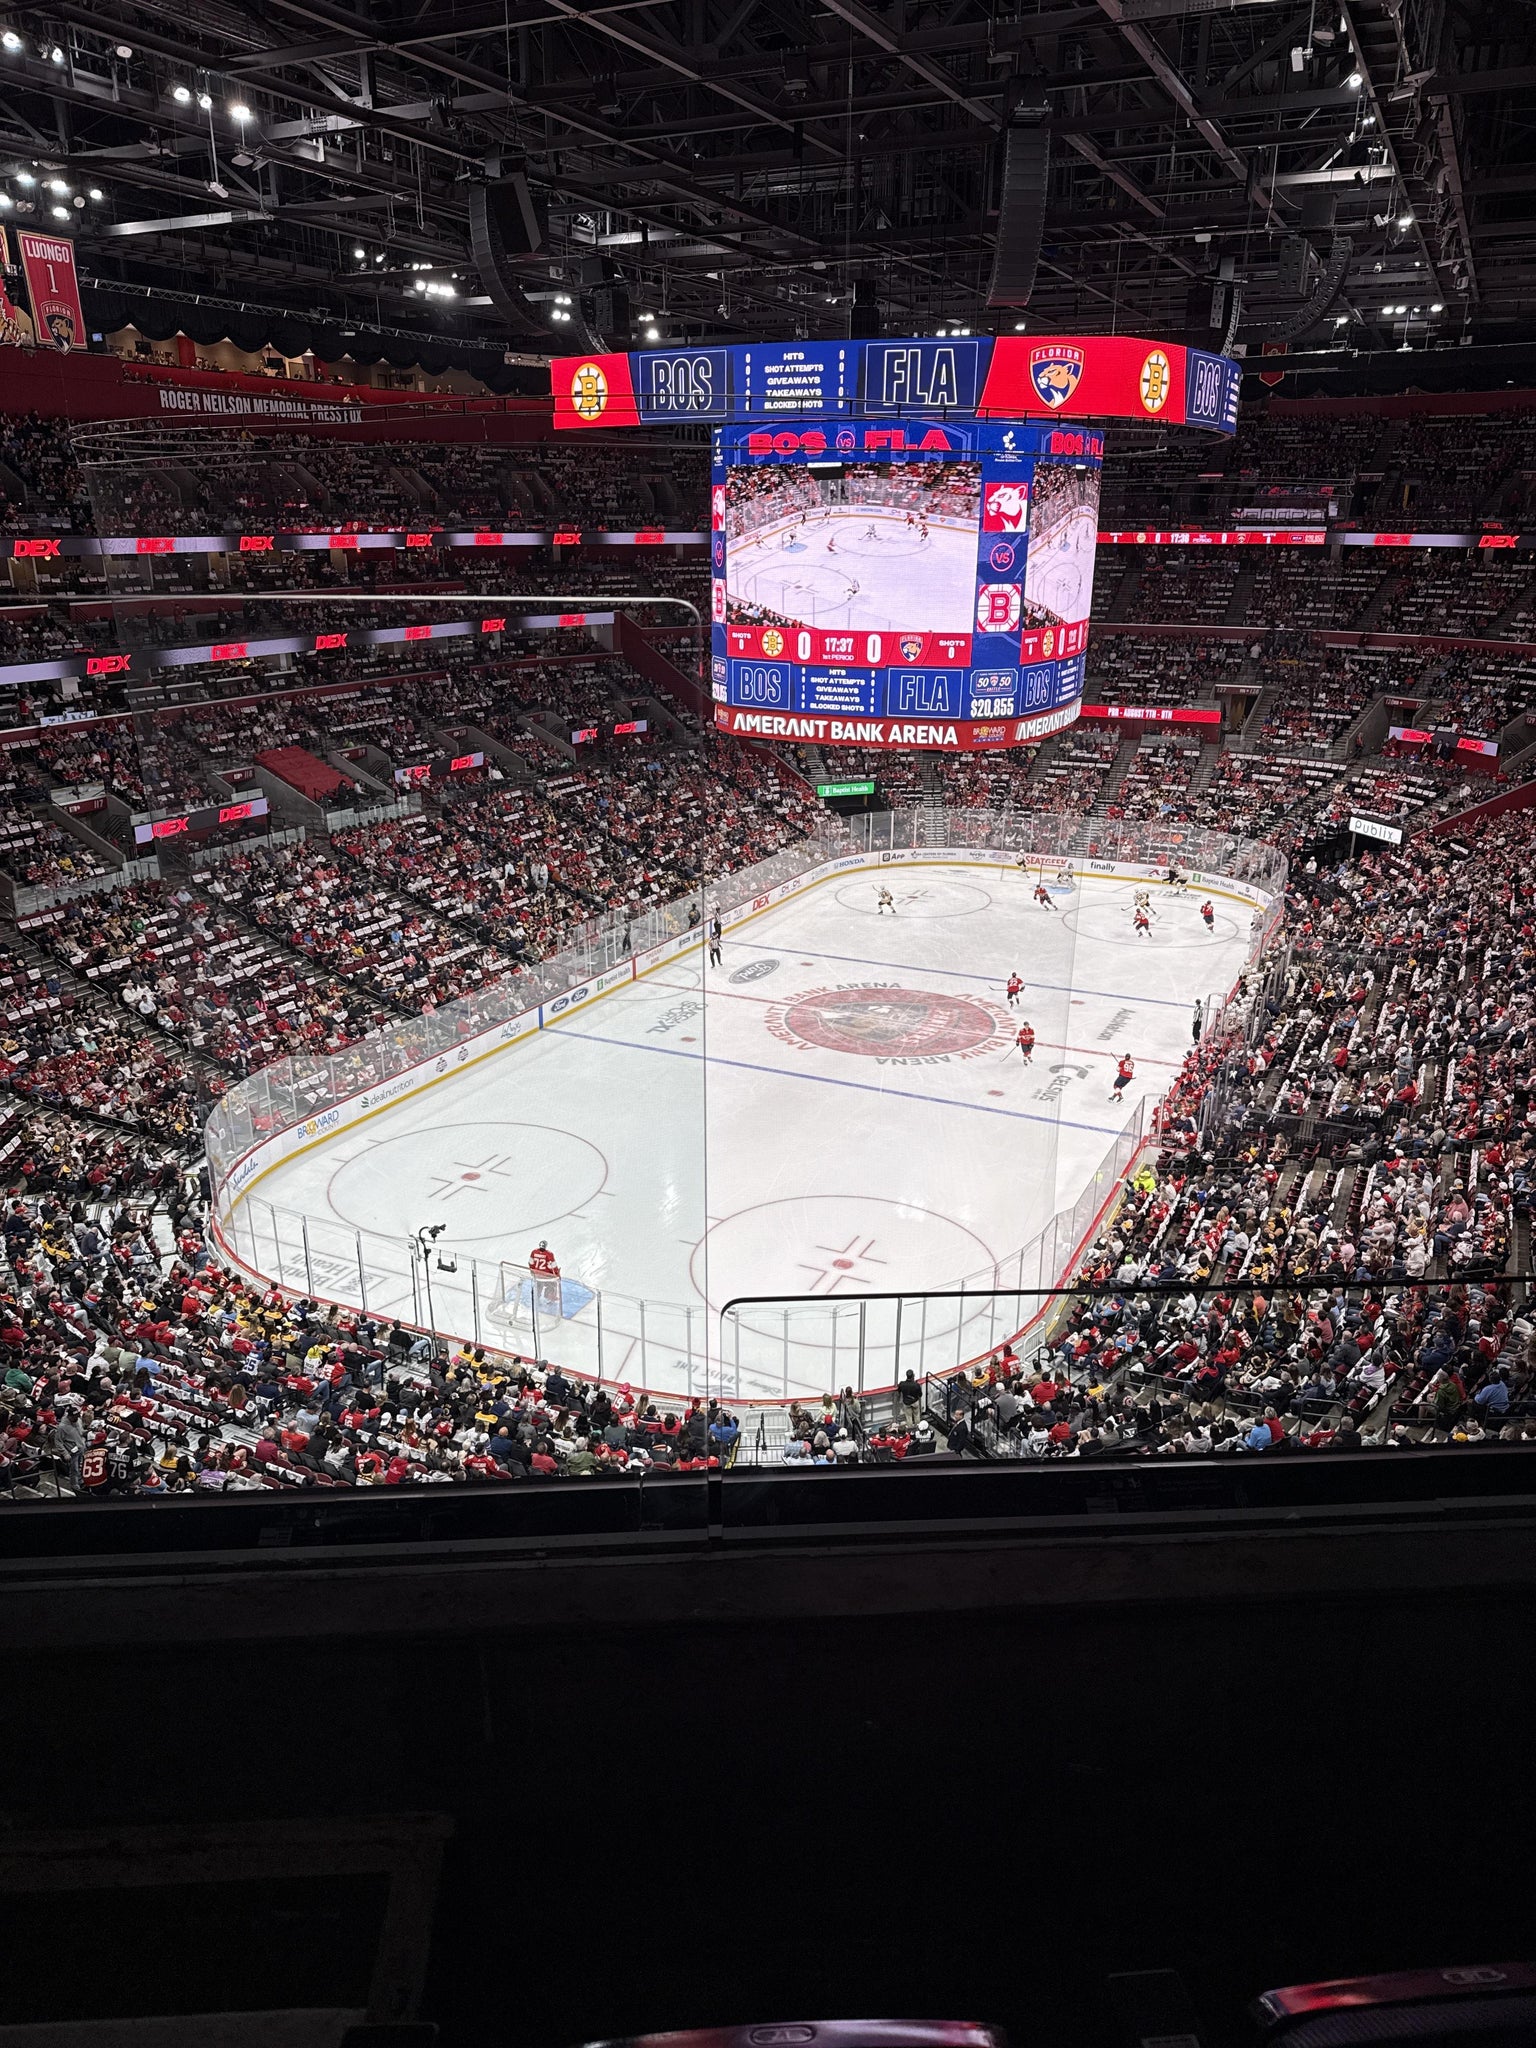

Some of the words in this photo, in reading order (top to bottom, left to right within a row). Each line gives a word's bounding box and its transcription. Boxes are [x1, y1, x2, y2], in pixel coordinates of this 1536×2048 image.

[25, 239, 70, 264] LUONGO
[46, 264, 59, 293] 1
[45, 305, 71, 317] FLORIDA
[745, 353, 750, 364] 0
[783, 352, 804, 361] HITS
[839, 350, 844, 360] 0
[1035, 347, 1079, 361] FLORIDA
[764, 365, 784, 374] SHOT
[785, 364, 824, 373] ATTEMPTS
[839, 362, 844, 373] 0
[652, 357, 712, 412] BOS
[746, 377, 750, 387] 1
[767, 376, 821, 386] GIVEAWAYS
[839, 374, 843, 385] 1
[883, 348, 957, 406] FLA
[1147, 363, 1164, 399] B
[580, 374, 598, 408] B
[765, 388, 822, 397] TAKEAWAYS
[838, 386, 844, 397] 0
[1193, 360, 1221, 417] BOS
[159, 390, 201, 411] ROGER
[202, 393, 250, 414] NEILSON
[252, 398, 310, 420] MEMORIAL
[764, 400, 797, 409] BLOCKED
[749, 432, 827, 455] BOS
[840, 437, 851, 447] VS
[865, 428, 952, 453] FLA
[1051, 431, 1083, 455] BOS
[136, 538, 175, 554] DEX
[239, 536, 275, 550] DEX
[329, 535, 358, 548] DEX
[406, 533, 434, 547] DEX
[553, 533, 581, 546] DEX
[1155, 533, 1160, 543] 0
[1221, 533, 1227, 543] 0
[1373, 533, 1414, 546] DEX
[1478, 535, 1520, 548] DEX
[14, 539, 60, 557] DEX
[995, 552, 1010, 564] VS
[988, 591, 1011, 625] B
[481, 618, 507, 633] DEX
[315, 633, 348, 650] DEX
[739, 639, 744, 650] 0
[797, 631, 811, 660] 0
[824, 637, 854, 653] 17:37
[866, 633, 881, 663] 0
[211, 643, 249, 661] DEX
[948, 647, 955, 659] 0
[87, 655, 131, 675] DEX
[740, 667, 781, 703] BOS
[816, 686, 859, 694] GIVEAWAYS
[828, 678, 865, 686] ATTEMPTS
[977, 677, 989, 688] 50
[999, 676, 1011, 687] 50
[1025, 668, 1050, 708] BOS
[815, 694, 860, 703] TAKEAWAYS
[899, 675, 949, 711] FLA
[810, 703, 840, 711] BLOCKED
[841, 704, 864, 712] SHOTS
[970, 698, 1014, 719] $20,855
[614, 722, 637, 735] DEX
[733, 712, 829, 739] AMERANT
[830, 720, 884, 742] BANK
[888, 724, 959, 745] ARENA
[1015, 713, 1066, 741] AMERANT
[450, 755, 474, 771] DEX
[219, 802, 255, 823] DEX
[151, 816, 191, 839] DEX
[1354, 820, 1394, 839] Publix
[839, 857, 865, 868] HONDA
[1090, 862, 1115, 873] finally
[1202, 876, 1219, 887] Baptist
[1219, 880, 1235, 890] Health
[752, 893, 770, 912] DEX
[574, 989, 588, 1001] Ford
[783, 986, 829, 1003] BANK
[836, 982, 902, 990] ARENA
[553, 1000, 568, 1011] Ford
[875, 1054, 952, 1067] ARENA
[296, 1109, 340, 1140] BROWARD
[534, 1257, 546, 1270] 72
[82, 1456, 104, 1478] 63
[109, 1460, 127, 1480] 76
